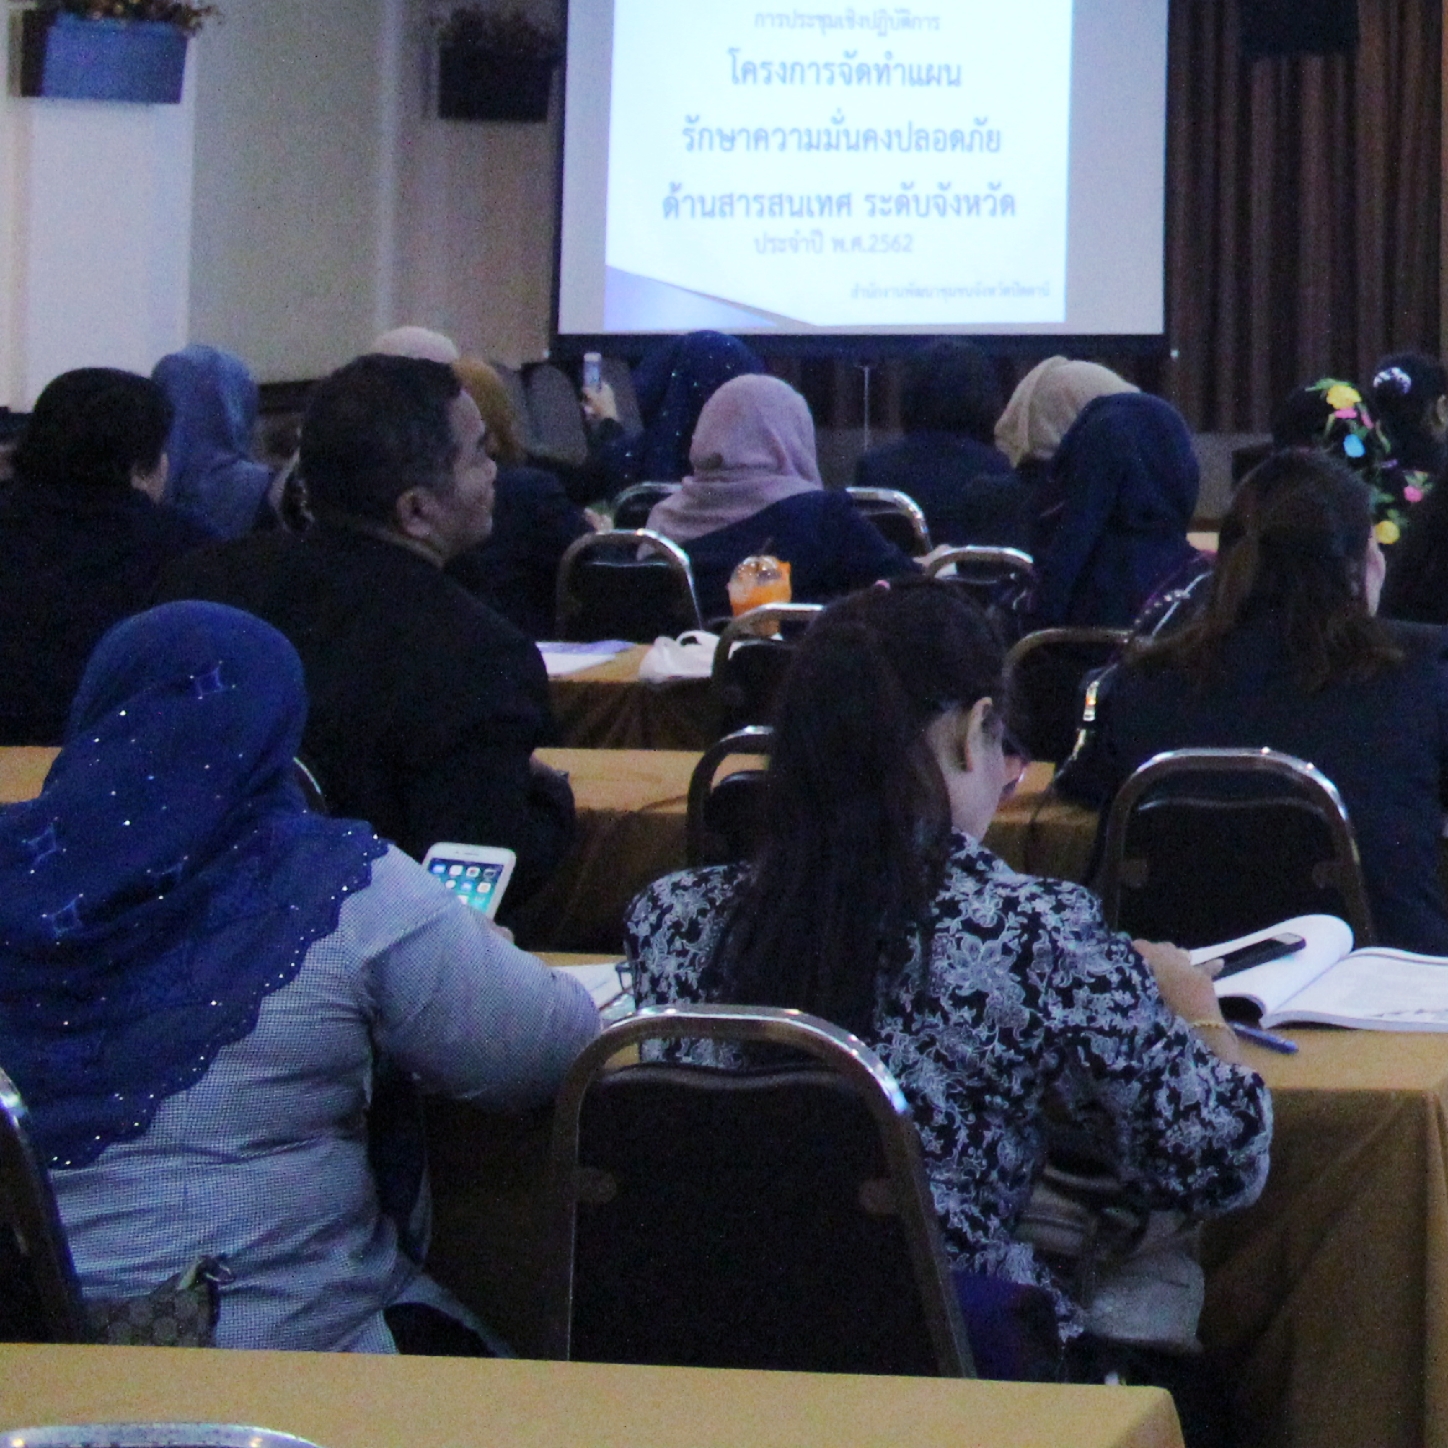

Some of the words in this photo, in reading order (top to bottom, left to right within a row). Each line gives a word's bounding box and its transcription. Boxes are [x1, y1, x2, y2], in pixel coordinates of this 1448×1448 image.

[727, 46, 962, 88] โครงการจัดทำแผน
[682, 108, 1002, 154] รักษาความมั่นคงปลอดภัย
[662, 181, 853, 220] ด้านสารสนเทศ
[864, 181, 1017, 219] ระดับจังหวัด
